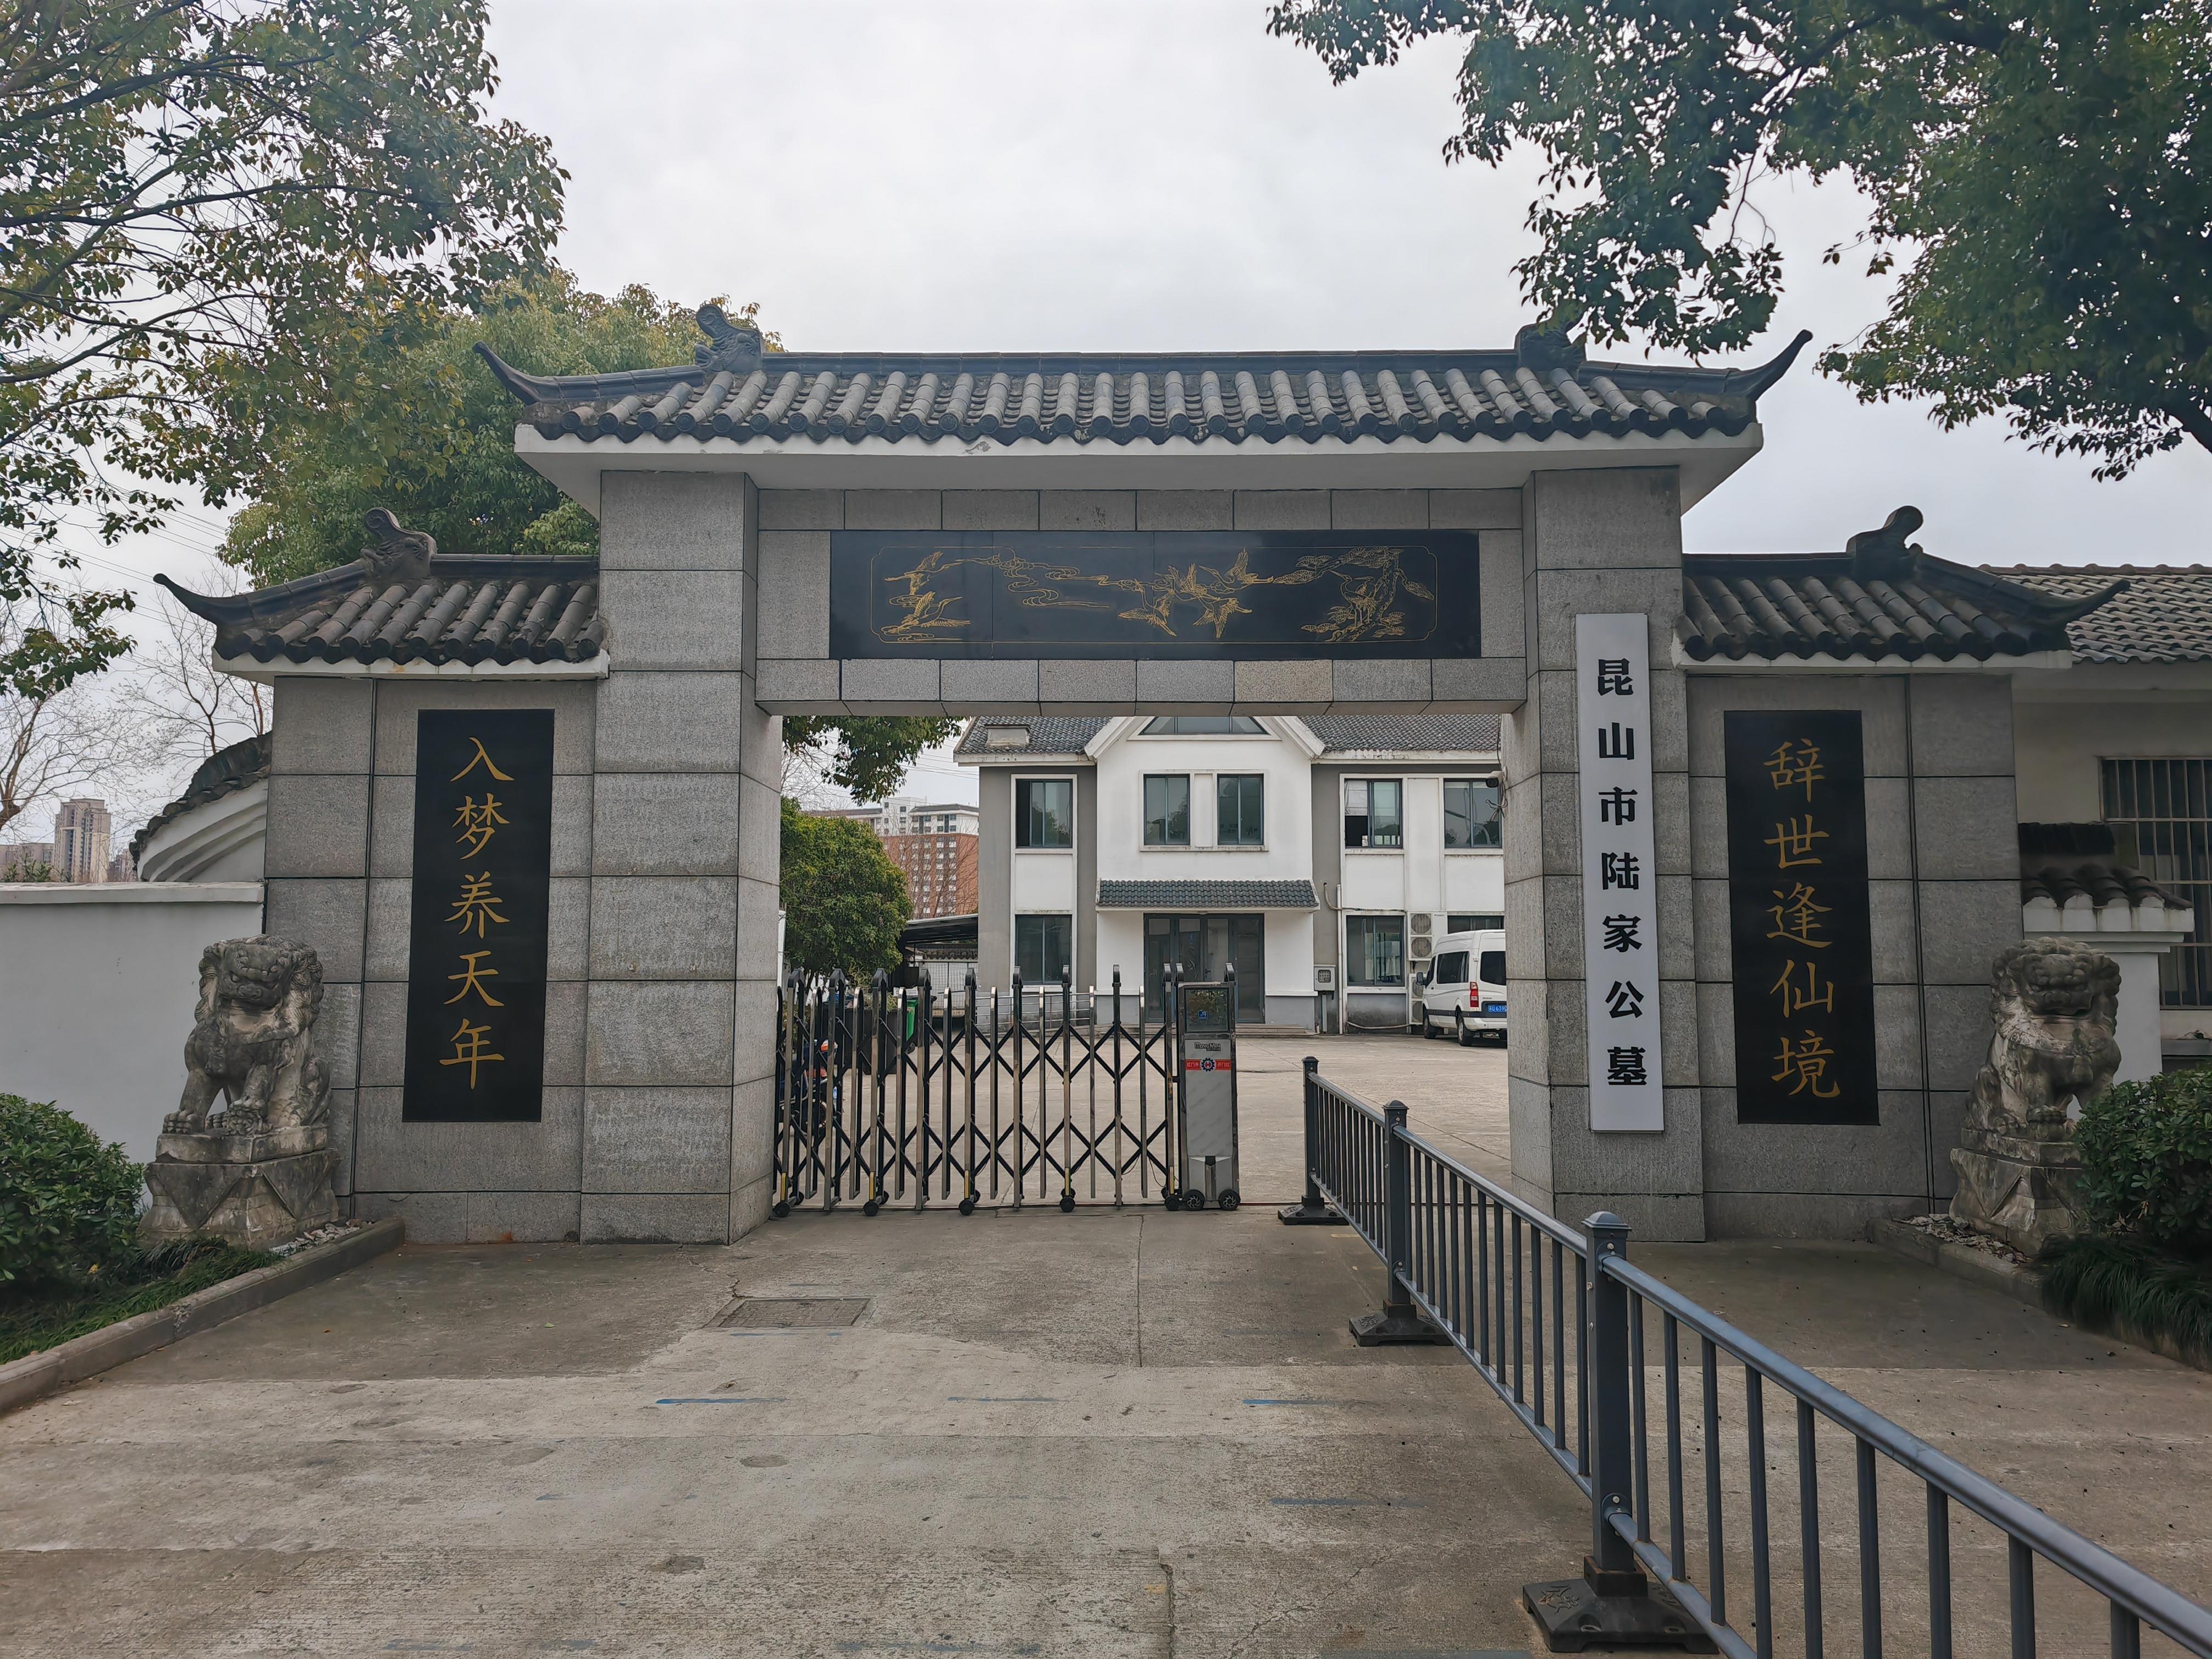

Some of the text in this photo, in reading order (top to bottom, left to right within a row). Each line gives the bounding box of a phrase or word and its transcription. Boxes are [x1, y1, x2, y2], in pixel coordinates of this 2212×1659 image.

[439, 737, 515, 1090] 入梦养天年
[1597, 658, 1647, 1086] 昆山市陆家公墓
[1763, 738, 1840, 1098] 辞世逢仙境
